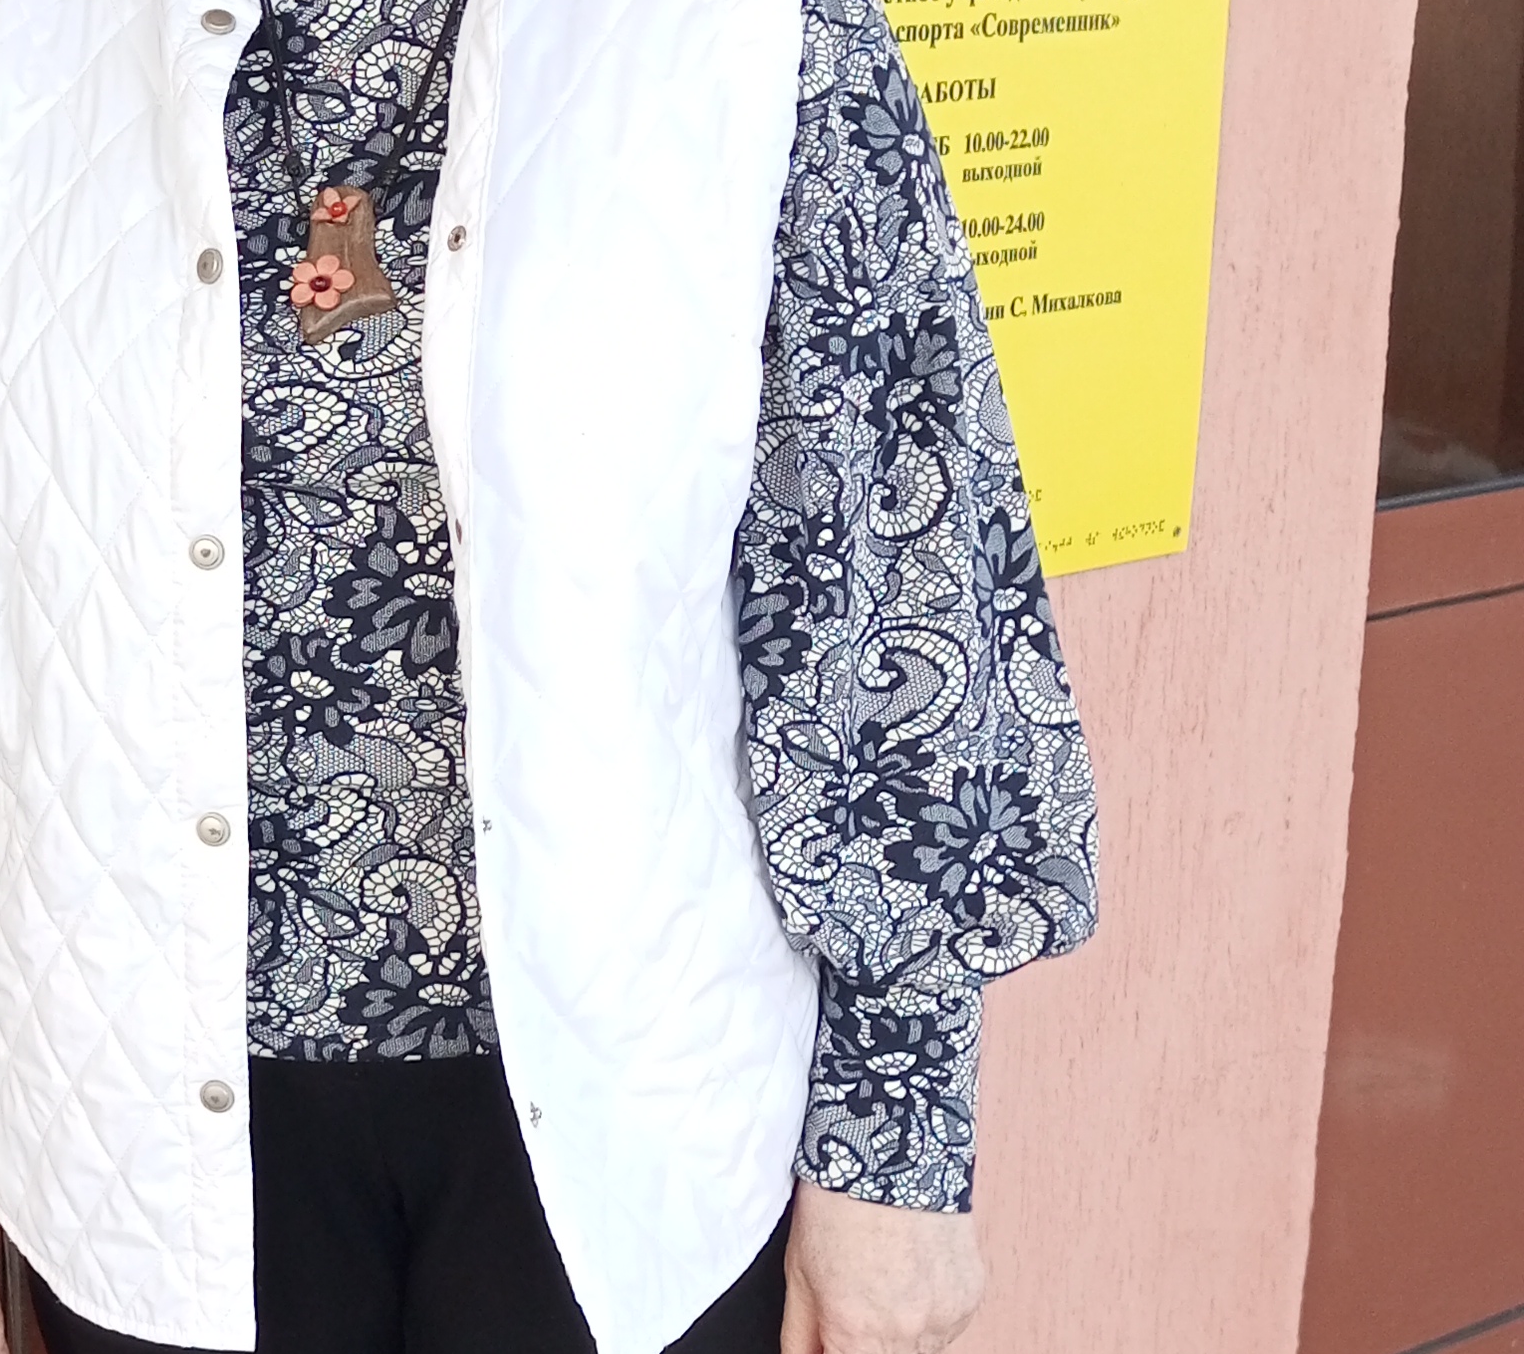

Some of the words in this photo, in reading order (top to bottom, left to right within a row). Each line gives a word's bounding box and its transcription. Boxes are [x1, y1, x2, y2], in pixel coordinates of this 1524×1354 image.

[895, 20, 964, 49] спорта
[970, 12, 1120, 43] «Современник»
[915, 77, 996, 103] АБОТЫ
[964, 126, 1050, 155] 10.00-22.00
[962, 156, 1043, 183] выходной
[962, 211, 1045, 239] 10.00-24.00
[1032, 289, 1123, 316] Михалкова
